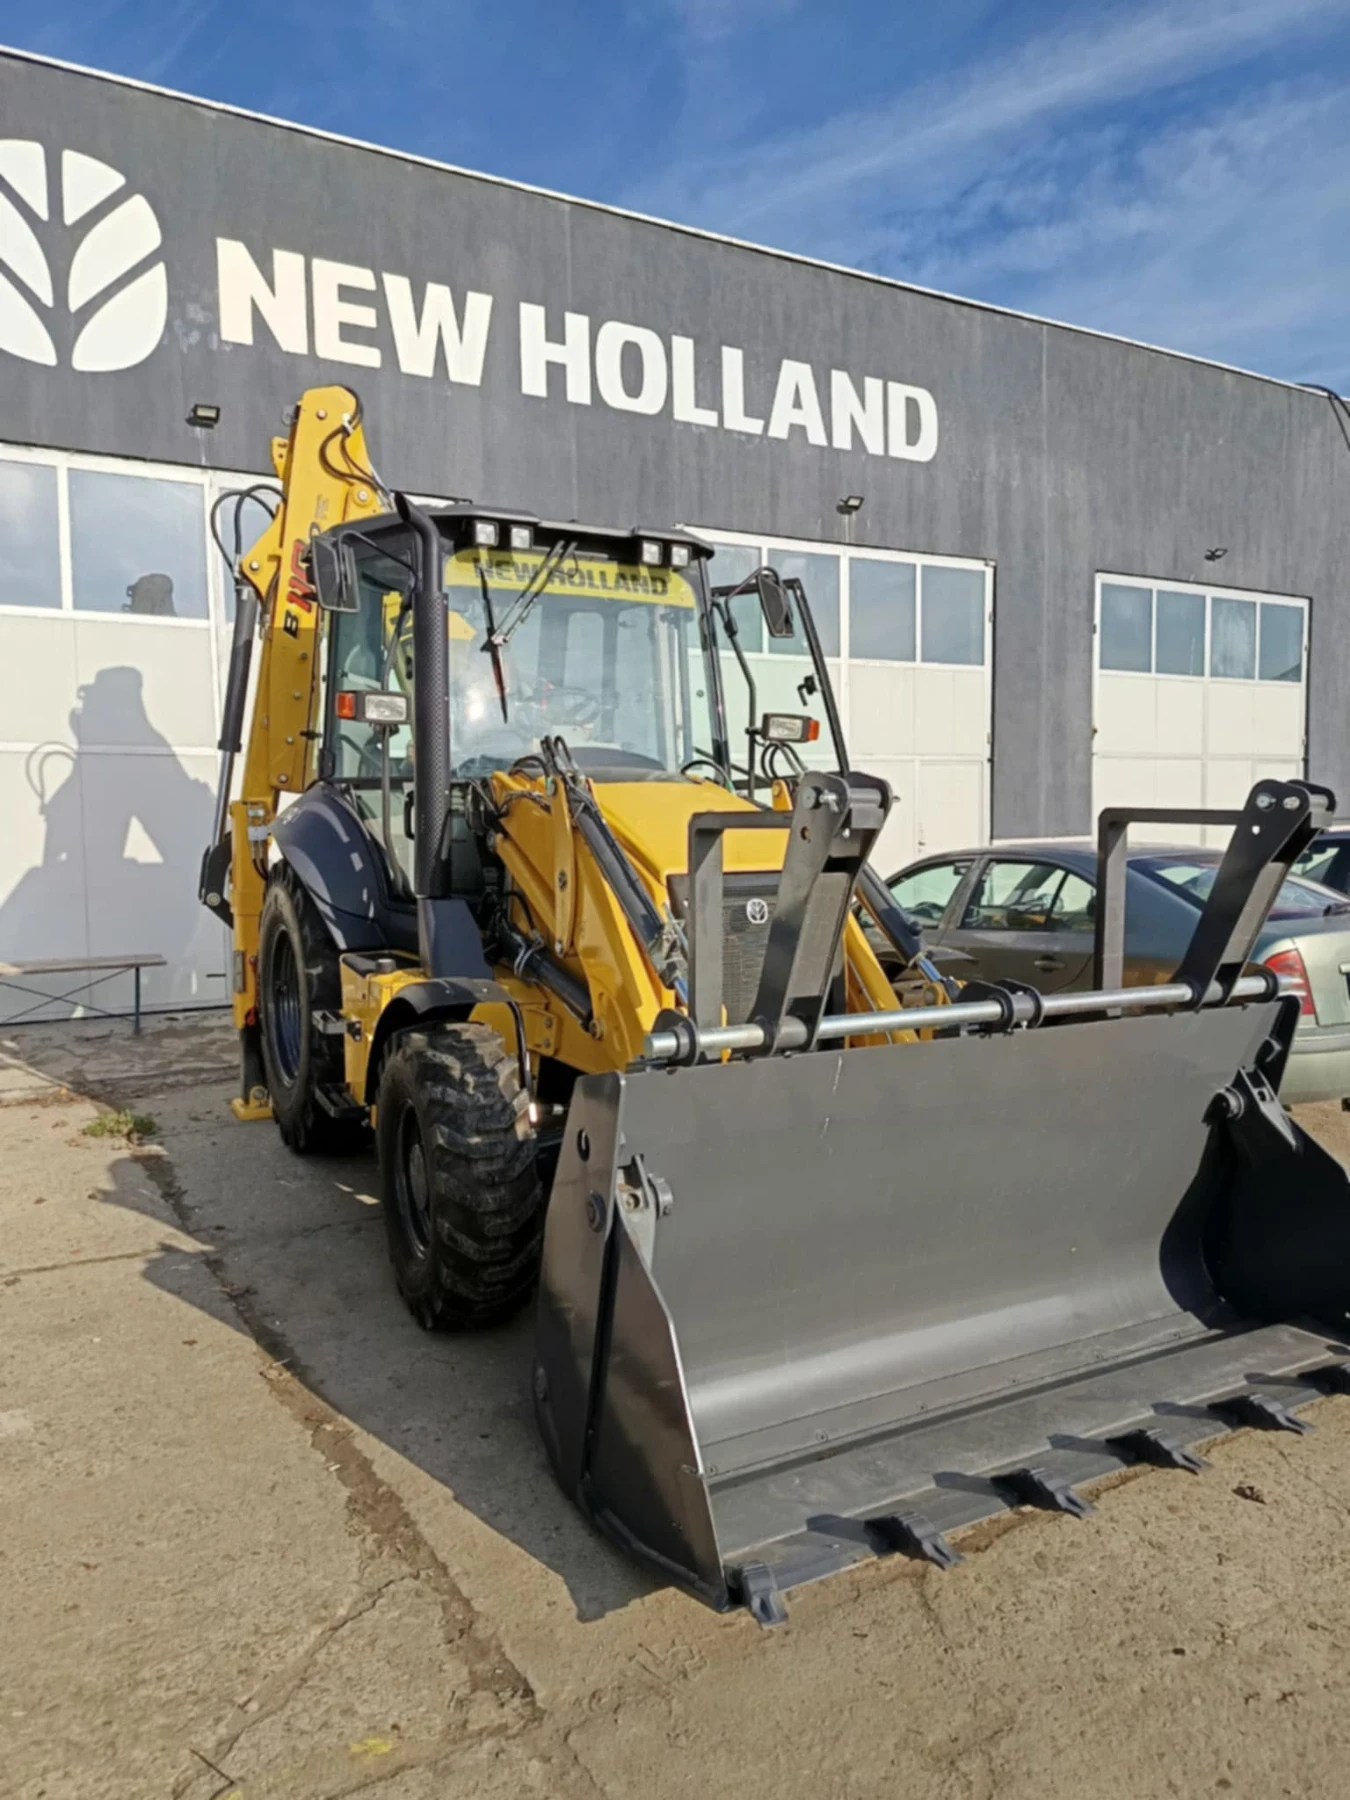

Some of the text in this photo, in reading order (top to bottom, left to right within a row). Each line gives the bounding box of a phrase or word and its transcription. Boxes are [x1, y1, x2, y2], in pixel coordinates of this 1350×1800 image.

[216, 237, 939, 463] NEW HOLLAND
[473, 557, 669, 597] NEW HOLLAND
